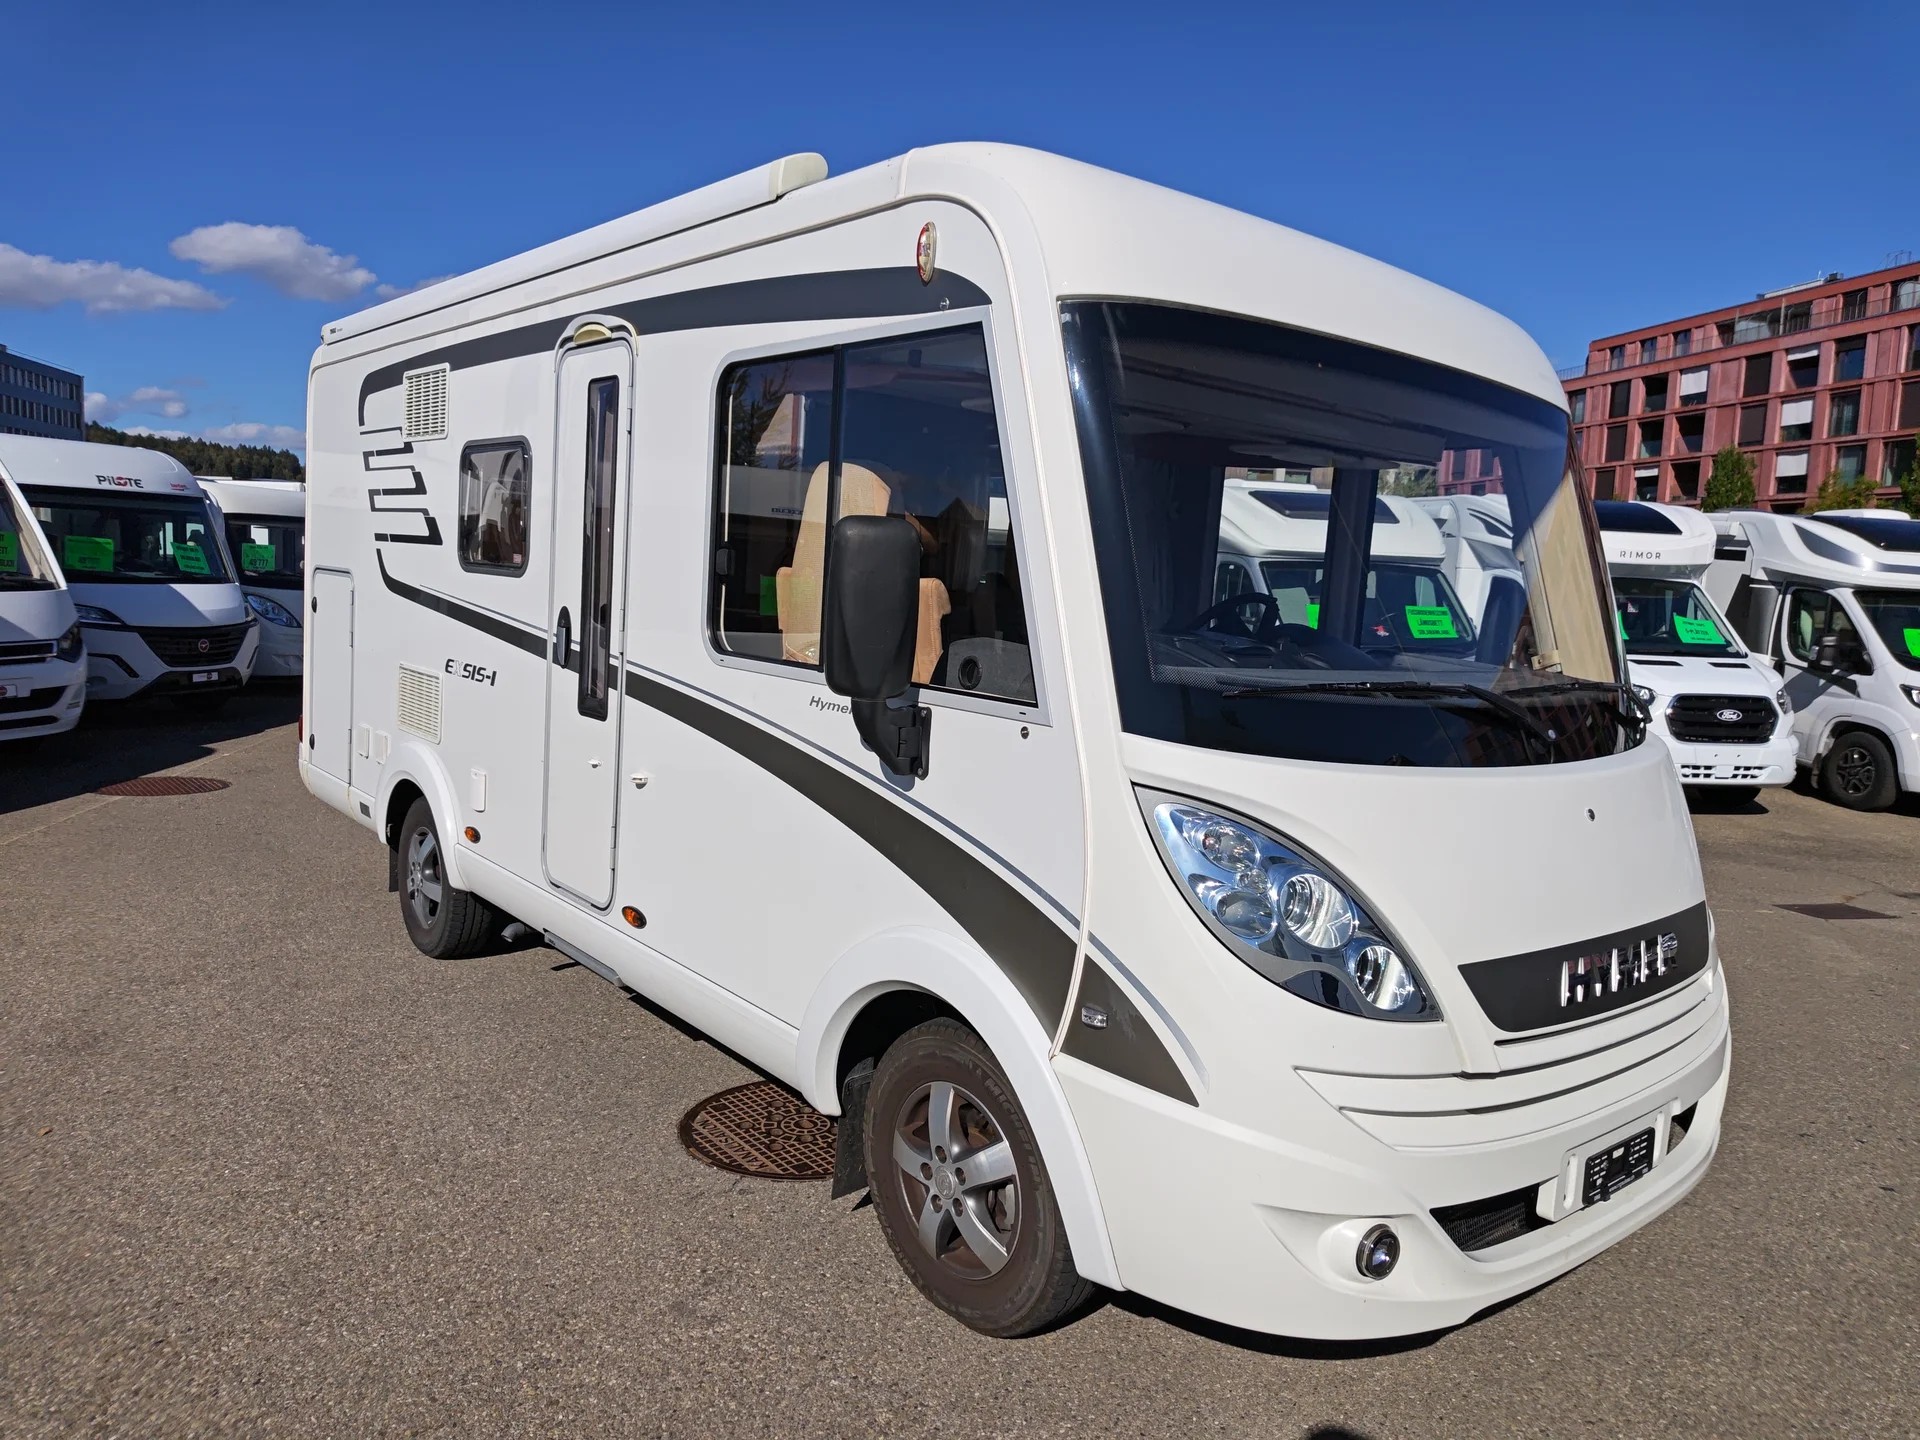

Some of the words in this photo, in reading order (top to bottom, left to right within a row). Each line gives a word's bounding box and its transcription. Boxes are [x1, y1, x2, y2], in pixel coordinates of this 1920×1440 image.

[1619, 550, 1661, 560] RIMOR
[809, 695, 852, 715] Hyme
[697, 1117, 770, 1171] KANALISATION
